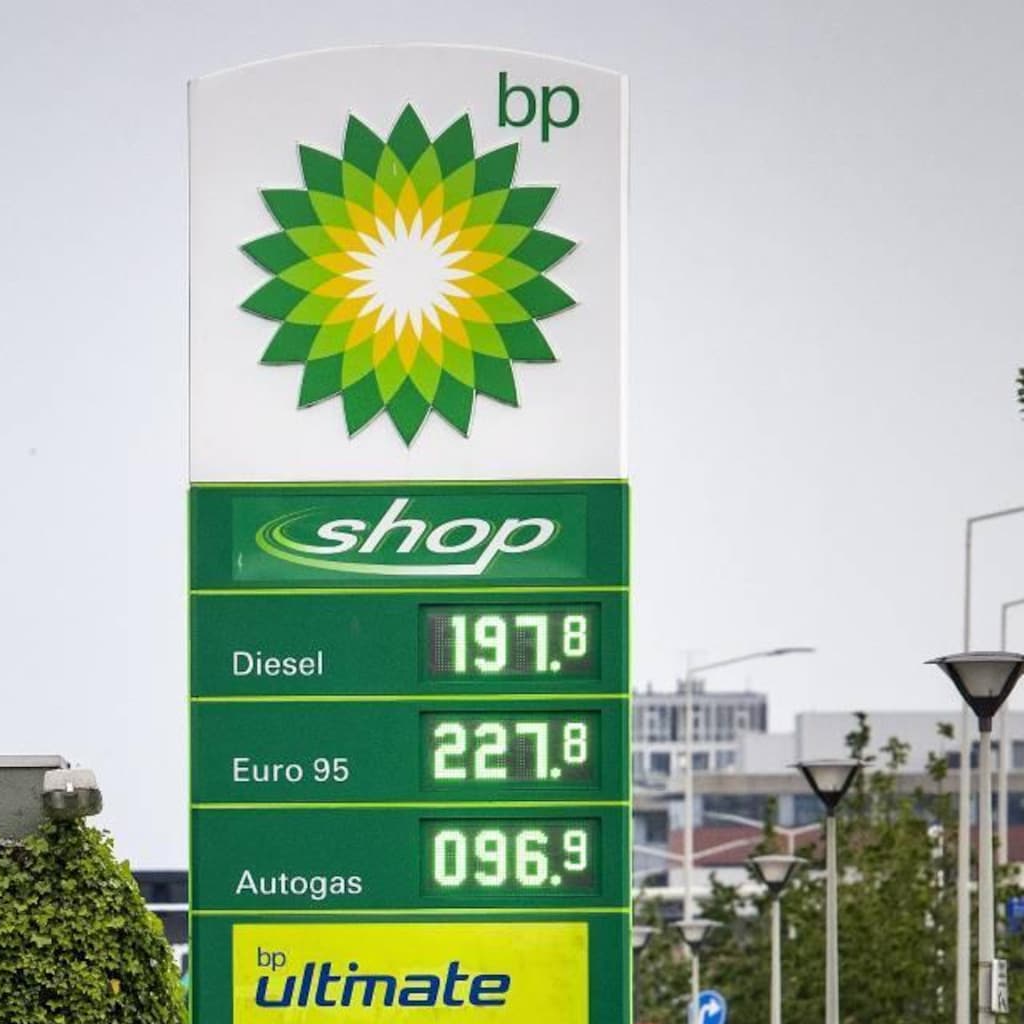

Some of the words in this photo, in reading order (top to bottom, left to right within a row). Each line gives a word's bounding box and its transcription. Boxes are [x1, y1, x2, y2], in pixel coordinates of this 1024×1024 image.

[498, 71, 580, 142] bp
[314, 498, 556, 575] shop
[232, 651, 323, 676] Diesel
[232, 758, 303, 782] Euro
[314, 758, 349, 782] 95
[236, 870, 363, 900] Autogas
[257, 947, 286, 971] bp
[255, 961, 511, 1008] ultimate
